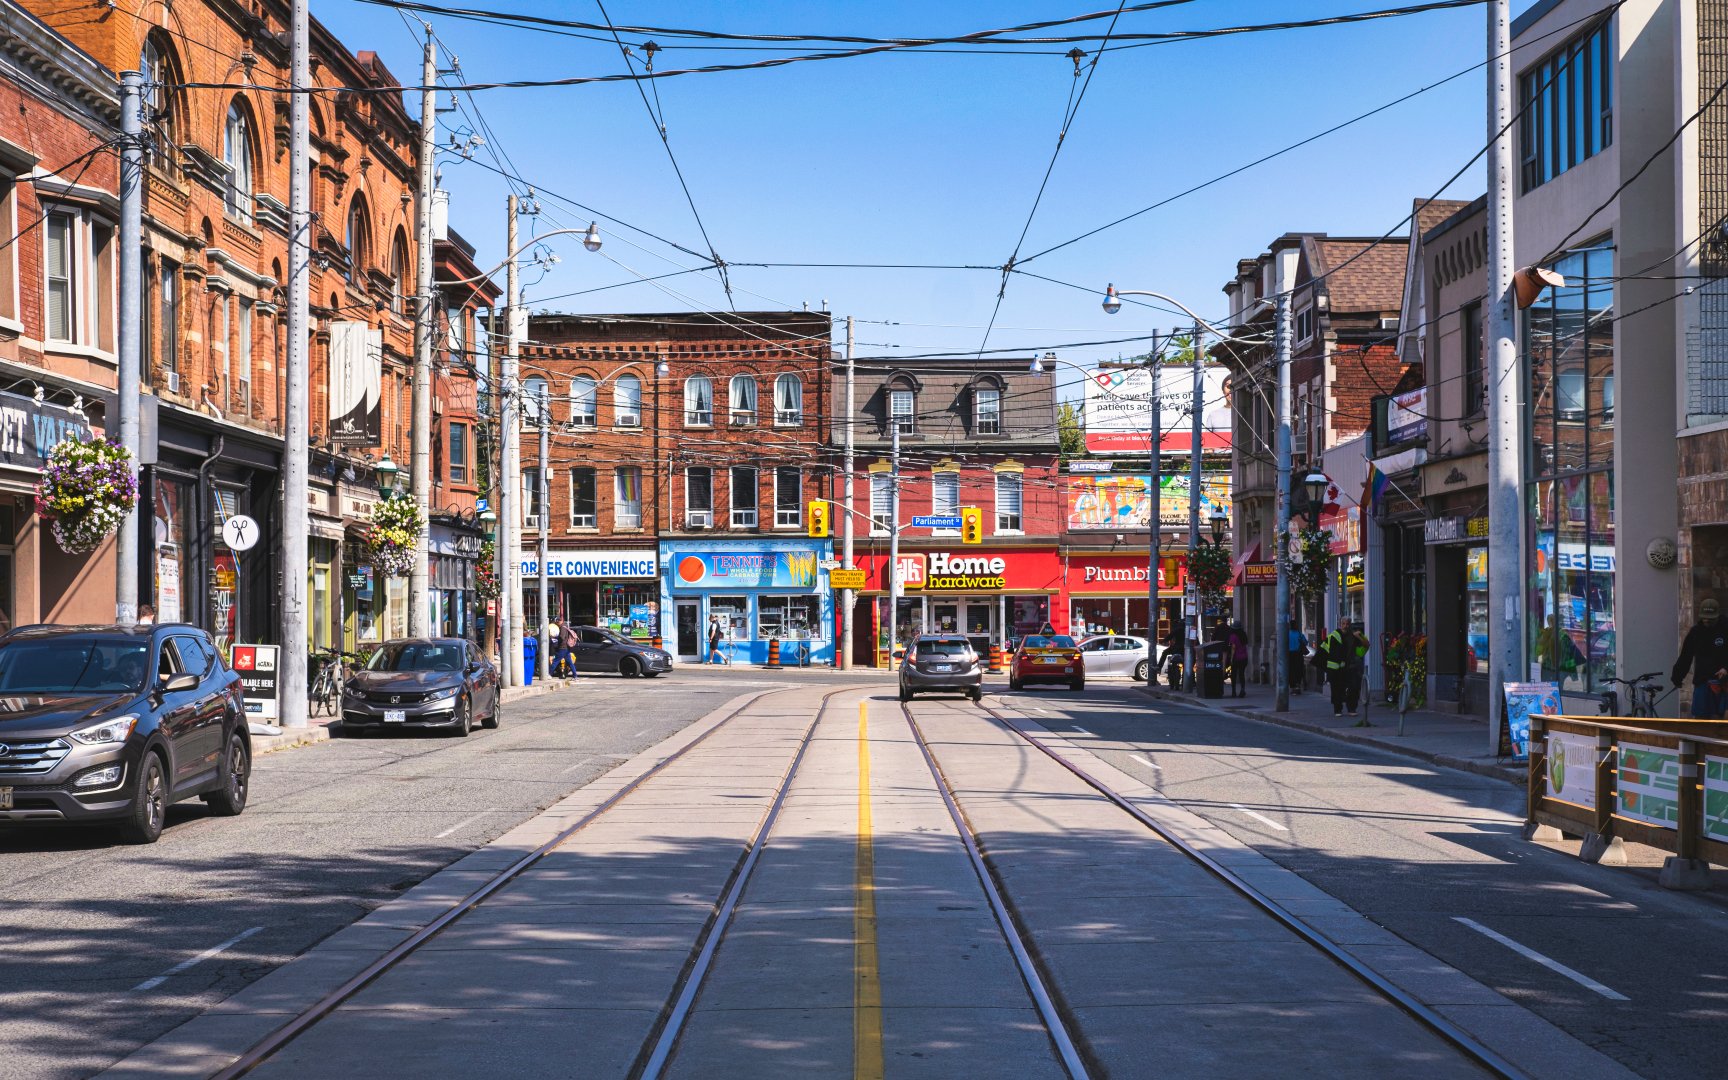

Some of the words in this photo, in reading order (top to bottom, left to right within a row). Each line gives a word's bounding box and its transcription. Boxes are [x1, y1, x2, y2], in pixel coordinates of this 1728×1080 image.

[1142, 392, 1151, 400] th
[1162, 392, 1180, 400] ives
[1182, 392, 1192, 400] of
[1097, 403, 1135, 411] patients
[1168, 403, 1191, 411] Cana
[915, 517, 954, 526] Parliament
[521, 561, 562, 575] ORER
[566, 560, 654, 575] CONVENIENCE
[712, 556, 777, 577] LENNIE'S
[929, 553, 1006, 575] Home
[1085, 566, 1164, 581] Plumbin
[1247, 566, 1261, 574] THAI
[929, 575, 1006, 588] hardware
[241, 679, 260, 687] AILABLE
[261, 680, 274, 688] HERE
